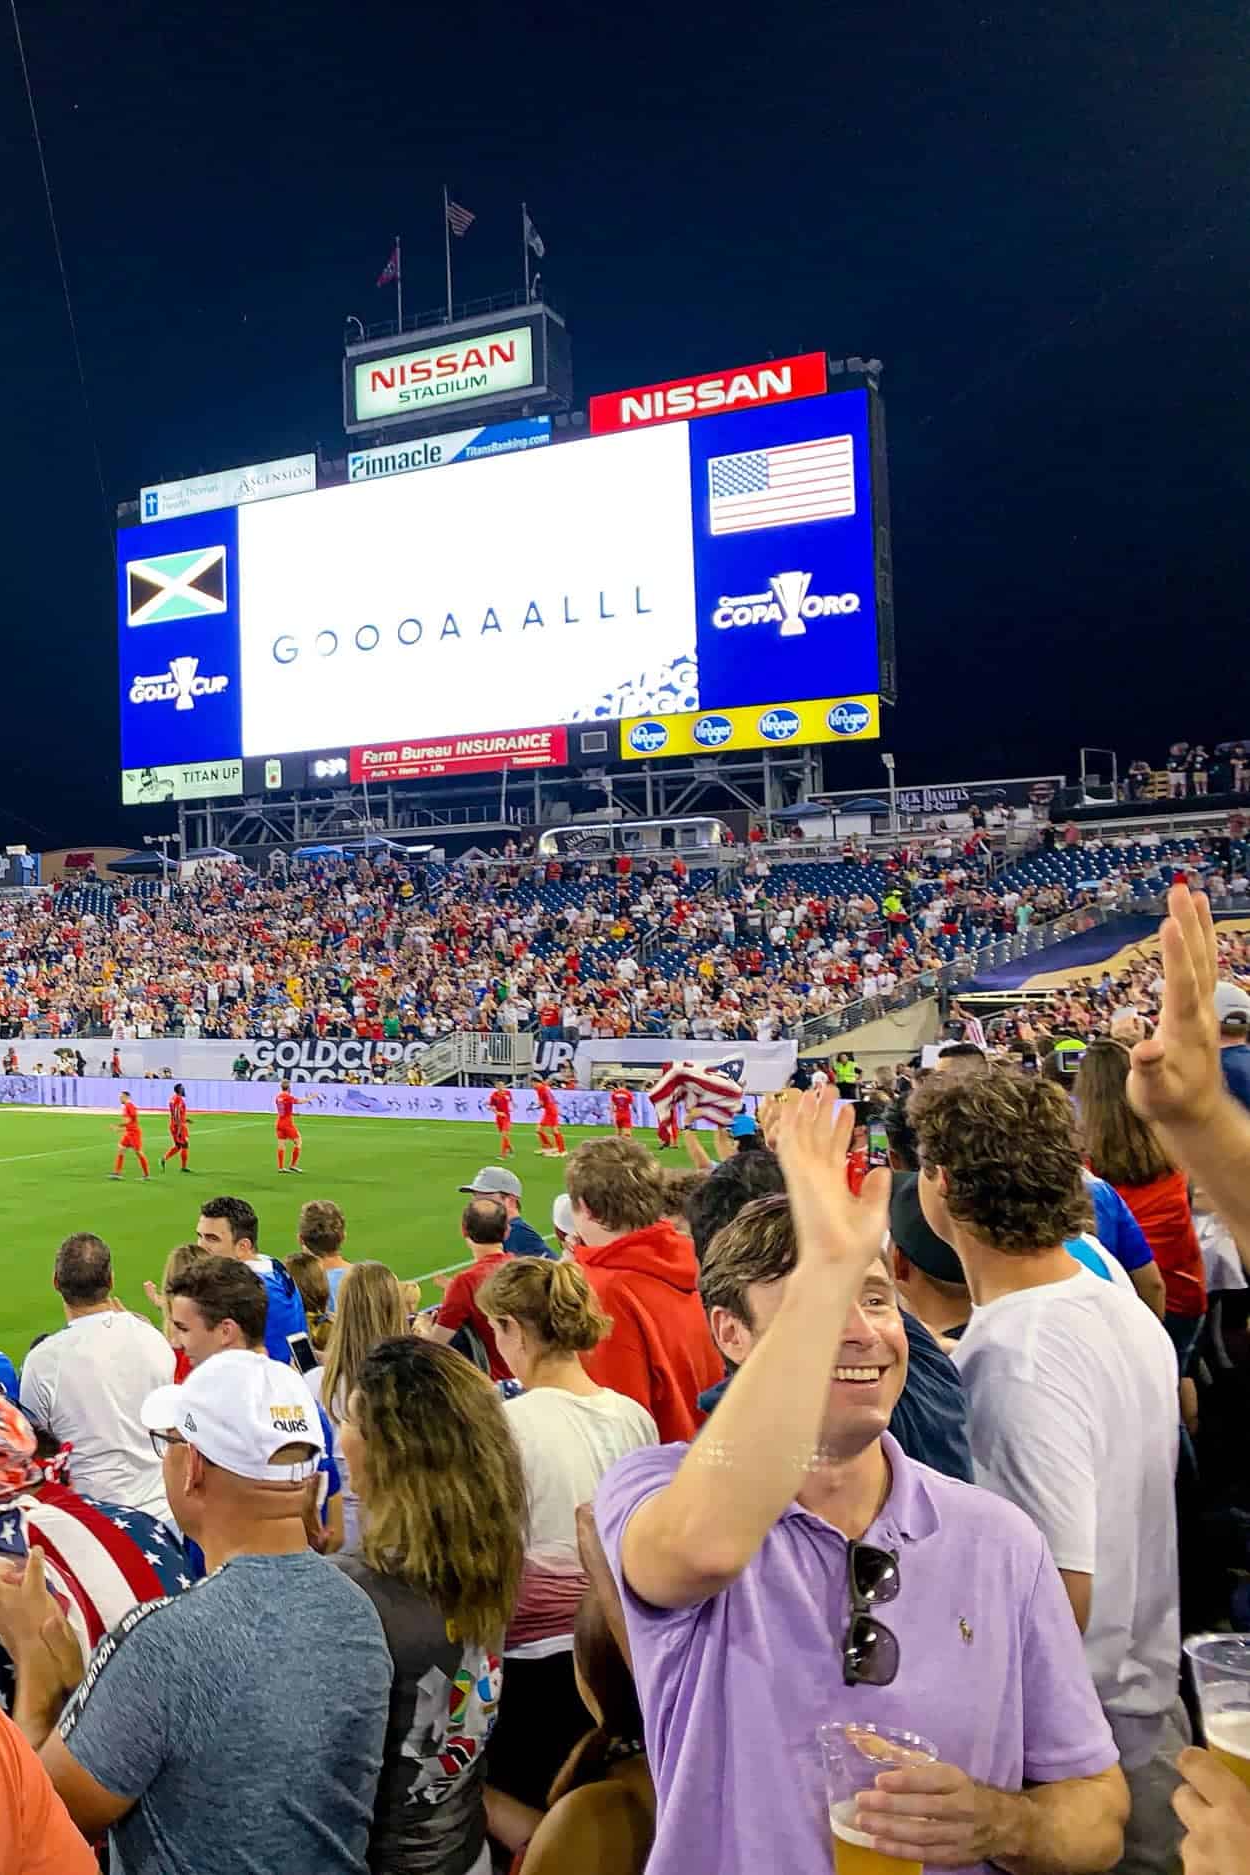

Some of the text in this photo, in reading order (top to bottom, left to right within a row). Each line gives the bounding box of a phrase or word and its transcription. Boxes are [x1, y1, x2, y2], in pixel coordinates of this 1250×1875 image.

[371, 340, 516, 393] NISSAN
[398, 374, 488, 403] STADIUM
[620, 366, 793, 424] NISSAN
[351, 443, 442, 479] Pinnacle
[272, 585, 652, 665] GOOOAAALLL
[712, 592, 861, 630] COPA ORO
[129, 675, 230, 704] GOLD CUP
[631, 707, 869, 750] Kroger Kroger Kroger Kroger
[362, 732, 553, 764] Farm Bureau INSURANCE
[182, 767, 240, 784] TITAN UP
[273, 1419, 309, 1433] OURS
